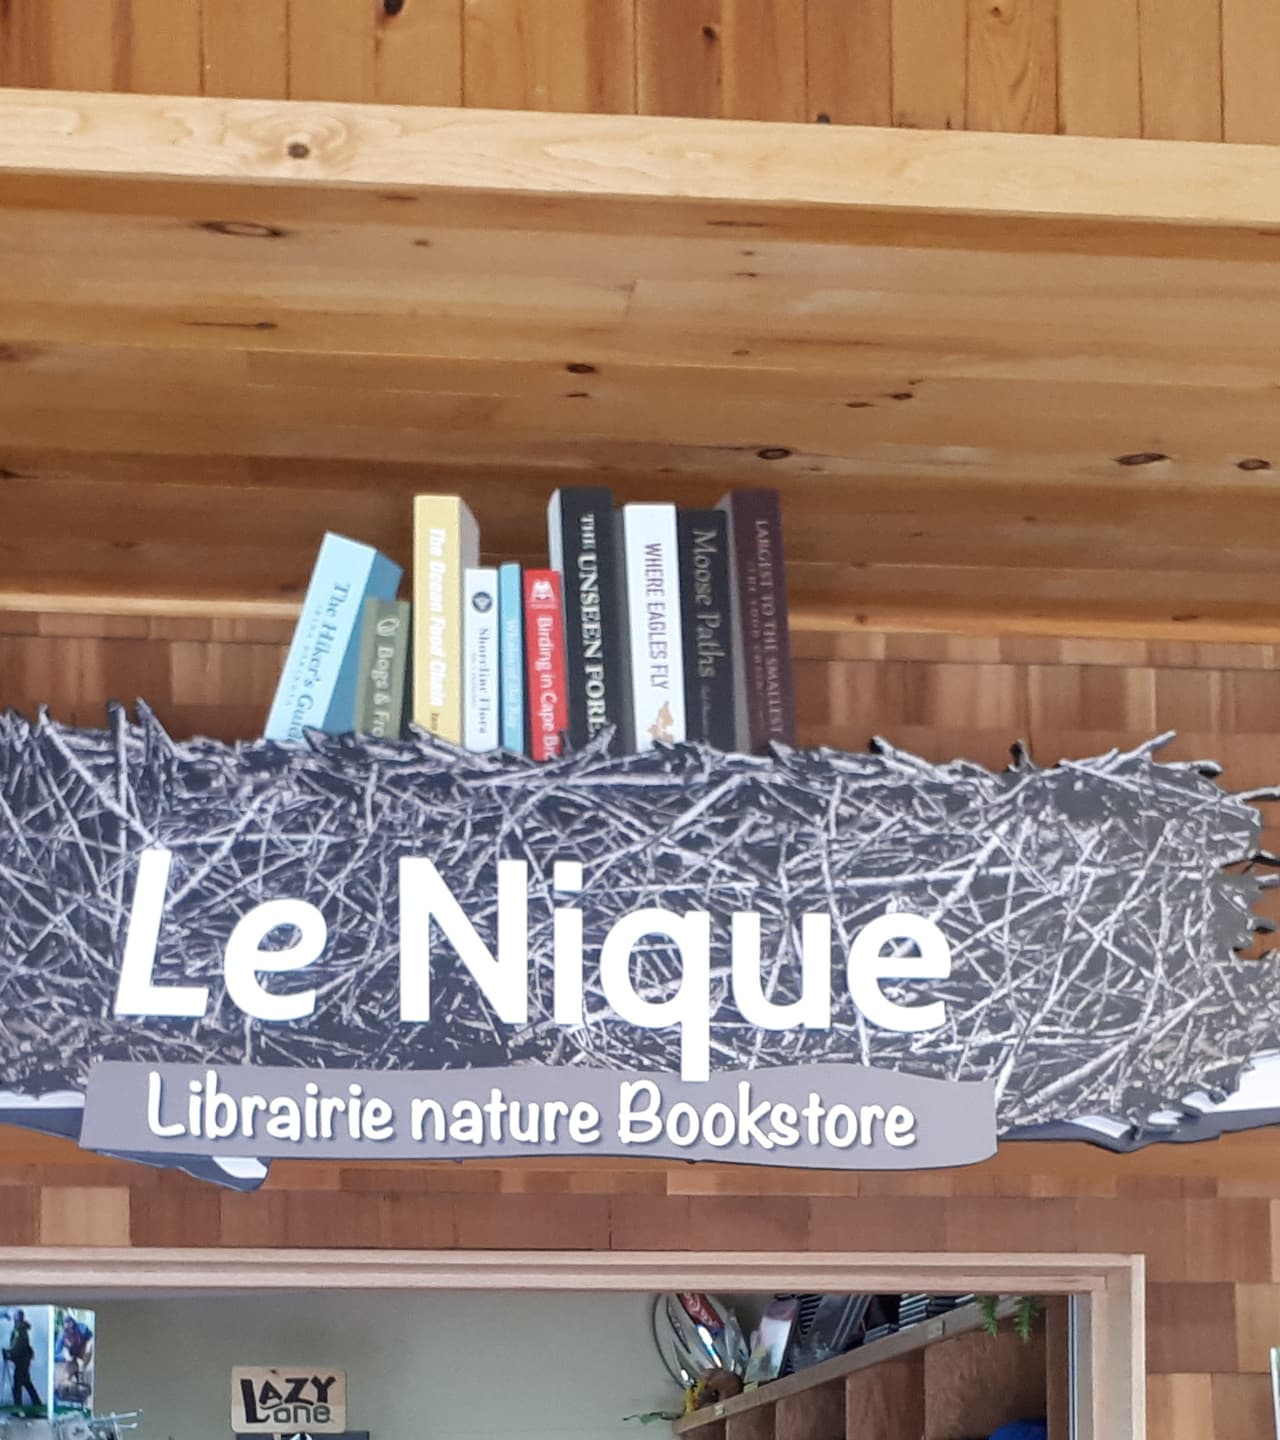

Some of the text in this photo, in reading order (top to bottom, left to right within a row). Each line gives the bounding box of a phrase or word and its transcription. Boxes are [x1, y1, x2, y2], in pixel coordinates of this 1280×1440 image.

[428, 528, 446, 557] The
[580, 514, 596, 549] THE
[428, 560, 446, 612] Ocean
[693, 529, 716, 606] Moose
[326, 581, 351, 617] The
[577, 554, 603, 659] UNSEEN
[644, 543, 670, 690] WHERE EAGLES FLY
[428, 616, 446, 657] Food
[536, 616, 553, 671] Birding
[696, 612, 725, 678] Paths
[756, 520, 783, 733] LARGEST TO THE SMALLEST
[304, 622, 337, 687] Hiker's
[371, 646, 395, 689] Bogs
[373, 693, 390, 705] &
[428, 661, 446, 707] Chain
[479, 627, 490, 735] Shoreline Flora
[540, 674, 555, 689] in
[540, 693, 558, 732] Cape
[115, 847, 952, 1081] Le Nique
[146, 1070, 917, 1150] Librairie nature Bookstore
[240, 1376, 336, 1424] LAZY
